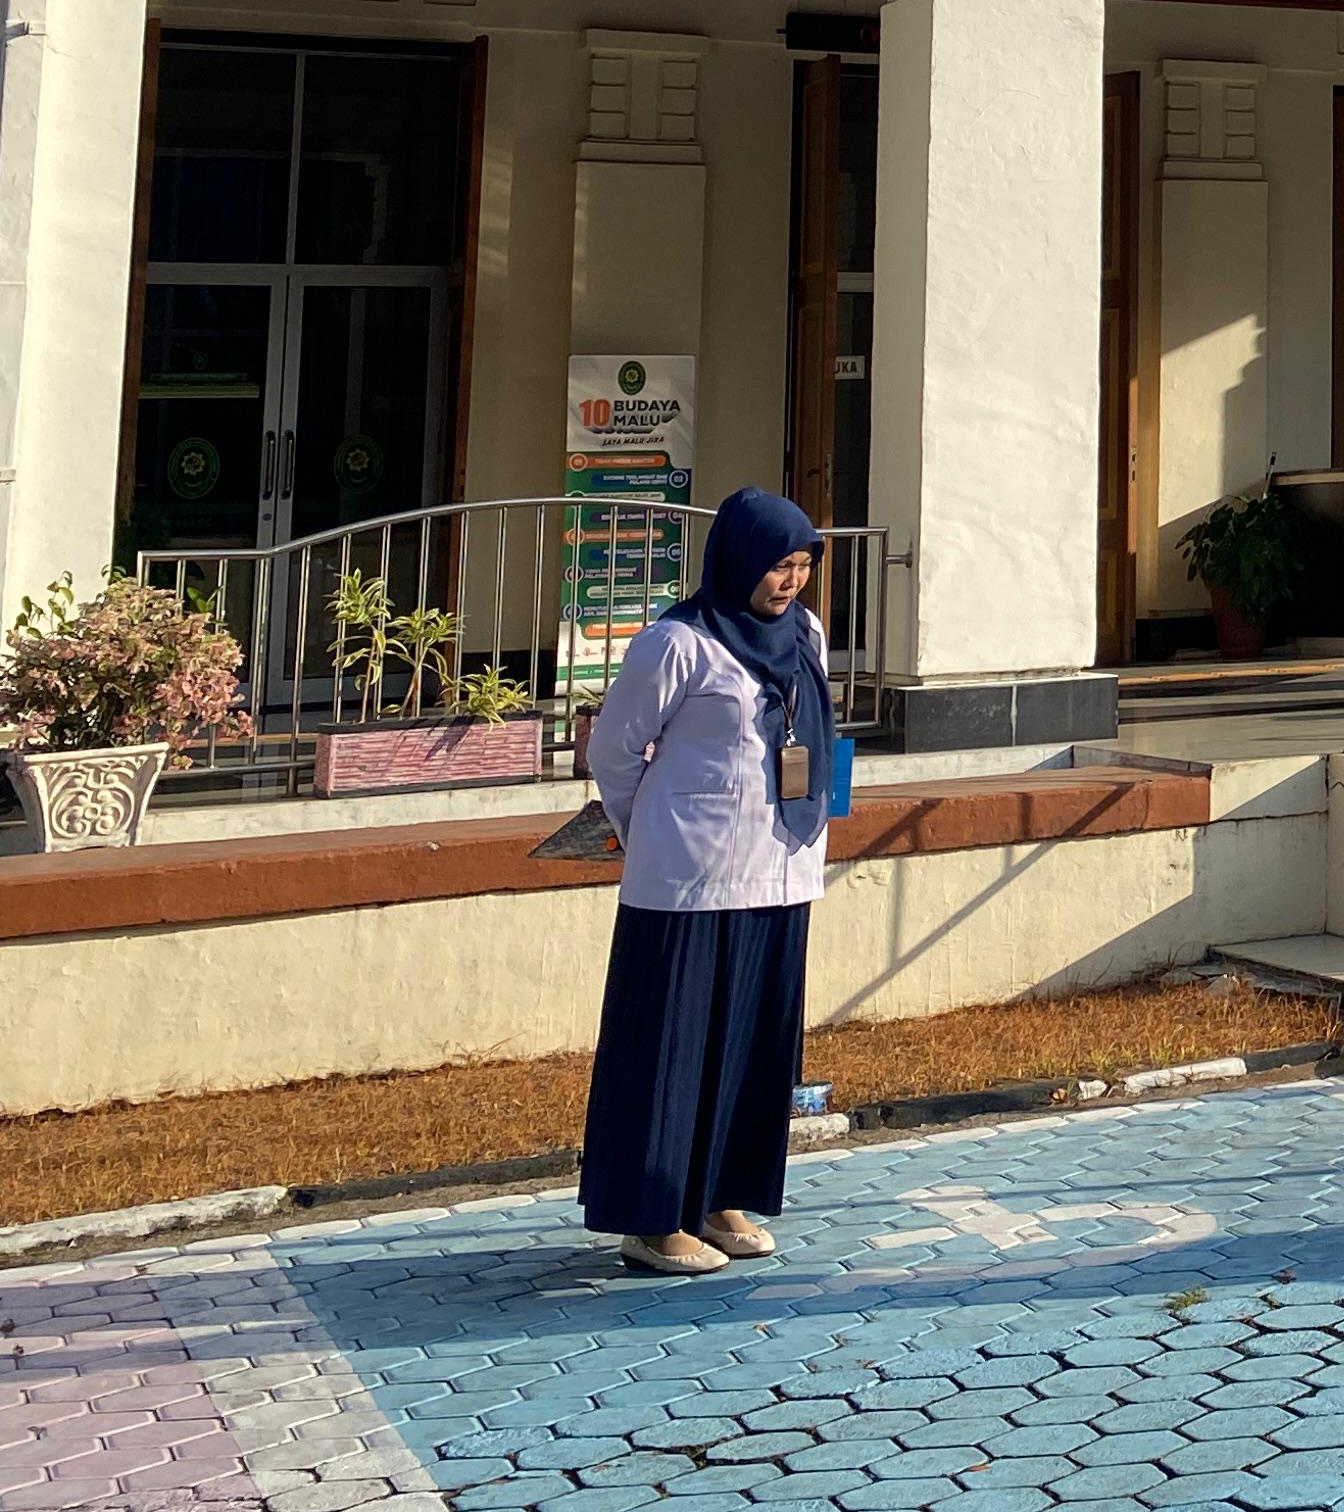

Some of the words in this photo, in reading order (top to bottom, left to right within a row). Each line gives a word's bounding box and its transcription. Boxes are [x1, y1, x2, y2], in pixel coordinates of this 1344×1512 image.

[834, 361, 857, 374] UKA
[579, 399, 610, 427] 10
[614, 400, 680, 411] BUDAYA
[614, 415, 660, 426] MALU
